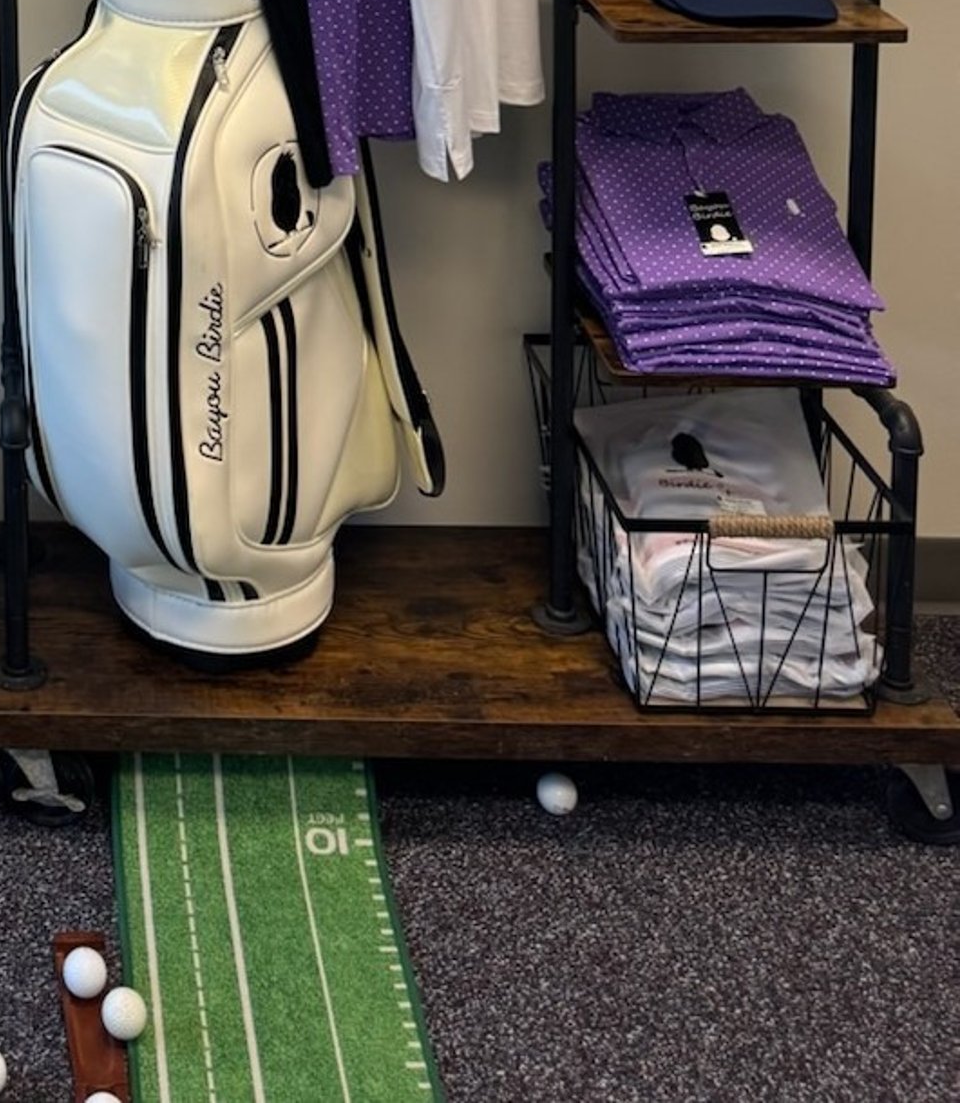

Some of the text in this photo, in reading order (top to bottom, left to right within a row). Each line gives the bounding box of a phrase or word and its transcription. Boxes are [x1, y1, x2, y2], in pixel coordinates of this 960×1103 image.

[196, 282, 228, 462] Bayou Birdie
[305, 827, 349, 855] 10
